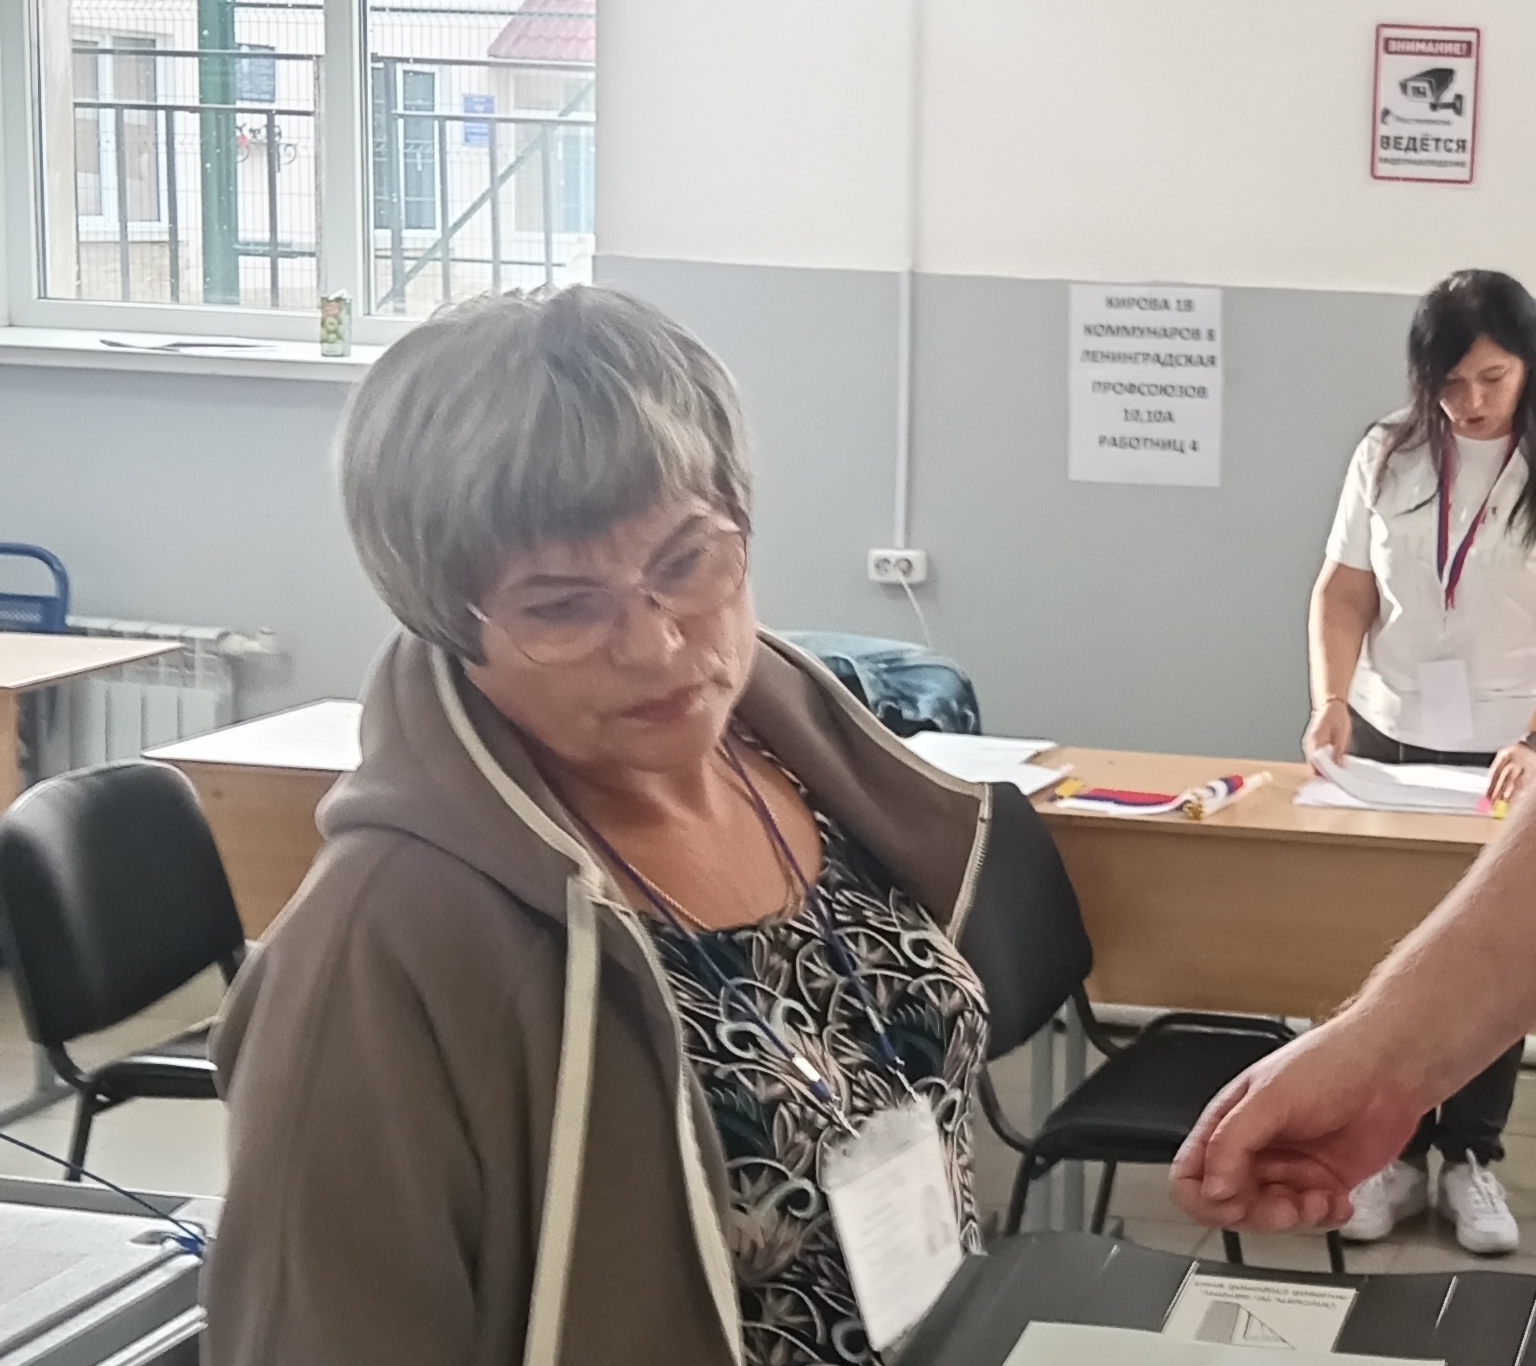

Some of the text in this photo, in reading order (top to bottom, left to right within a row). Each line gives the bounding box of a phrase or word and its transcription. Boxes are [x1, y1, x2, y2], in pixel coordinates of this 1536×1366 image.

[1388, 39, 1467, 56] ВНИМАНИЕ!
[1380, 133, 1467, 154] ВЕДЁТСЯ
[1105, 295, 1171, 312] КИРОВА
[1083, 323, 1202, 341] КОММУНАРОВ
[1080, 349, 1217, 368] ЛЕНИНГРАДСКАЯ
[1091, 380, 1208, 399] ПРОФСОЮЗОВ
[1098, 435, 1185, 453] РАБОТНИЦ
